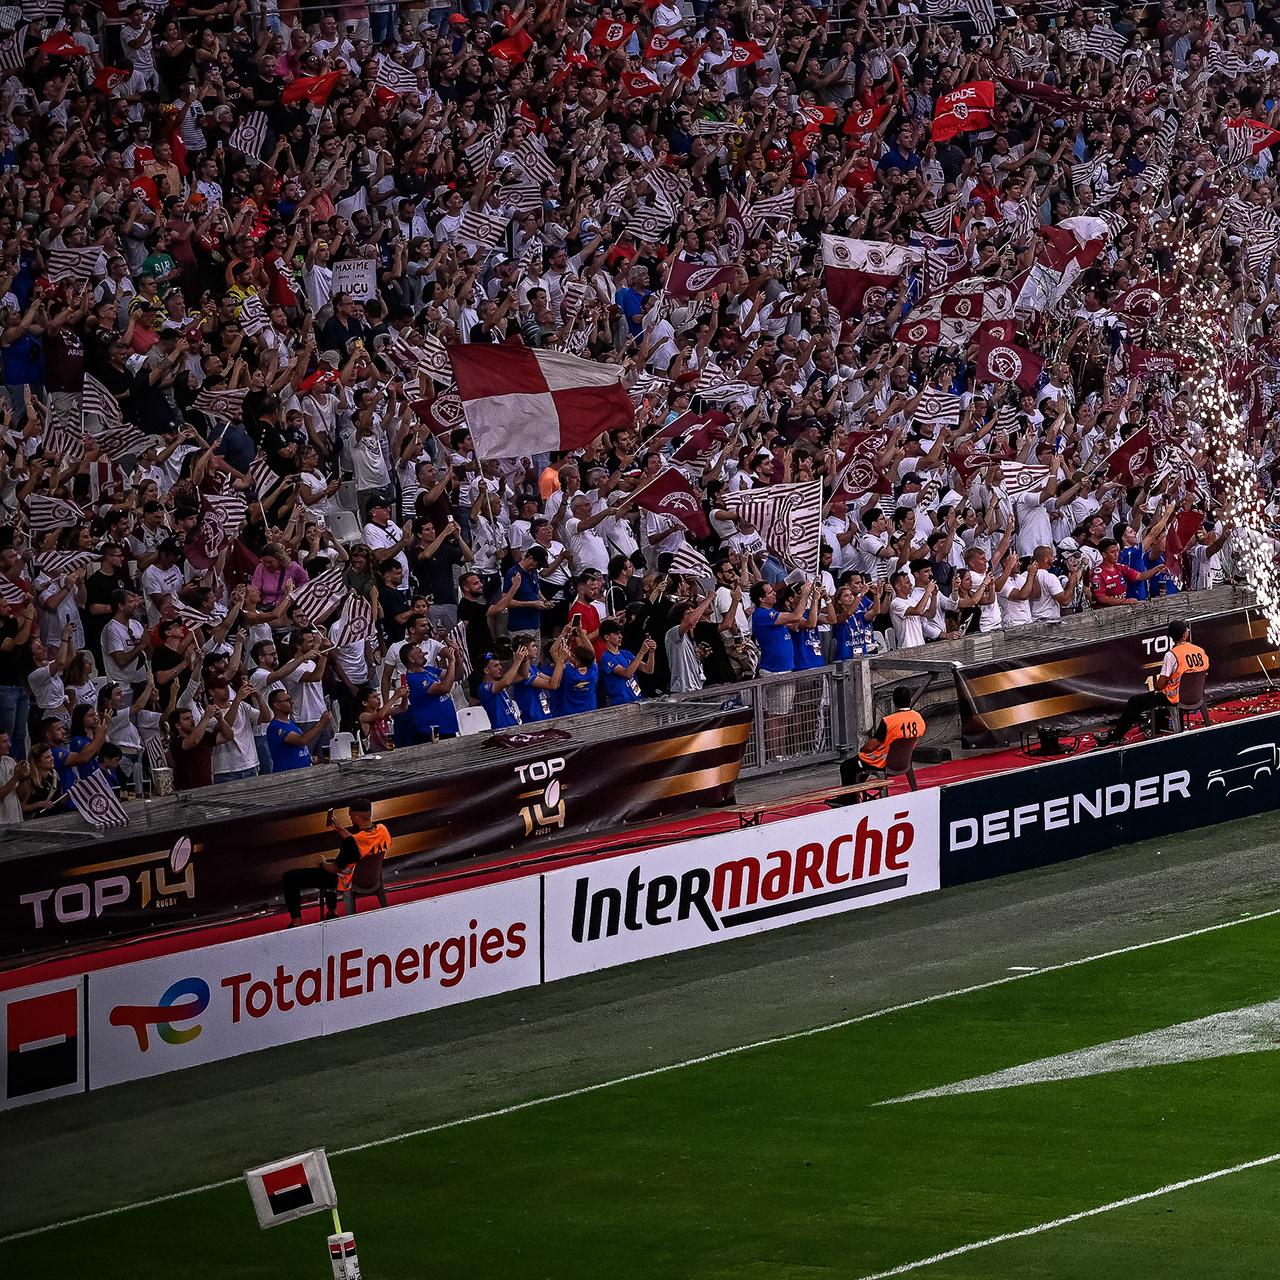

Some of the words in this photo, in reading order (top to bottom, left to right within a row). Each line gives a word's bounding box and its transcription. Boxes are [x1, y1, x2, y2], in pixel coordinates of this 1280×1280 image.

[945, 87, 976, 103] STADE
[336, 261, 369, 272] MAXIME
[340, 282, 368, 294] LUCU
[900, 721, 918, 738] 118
[514, 757, 566, 784] TOP
[518, 798, 566, 837] 14
[949, 769, 1191, 852] DEFENDER
[155, 897, 178, 908] RUGBY
[221, 919, 527, 1024] TotalEnergies
